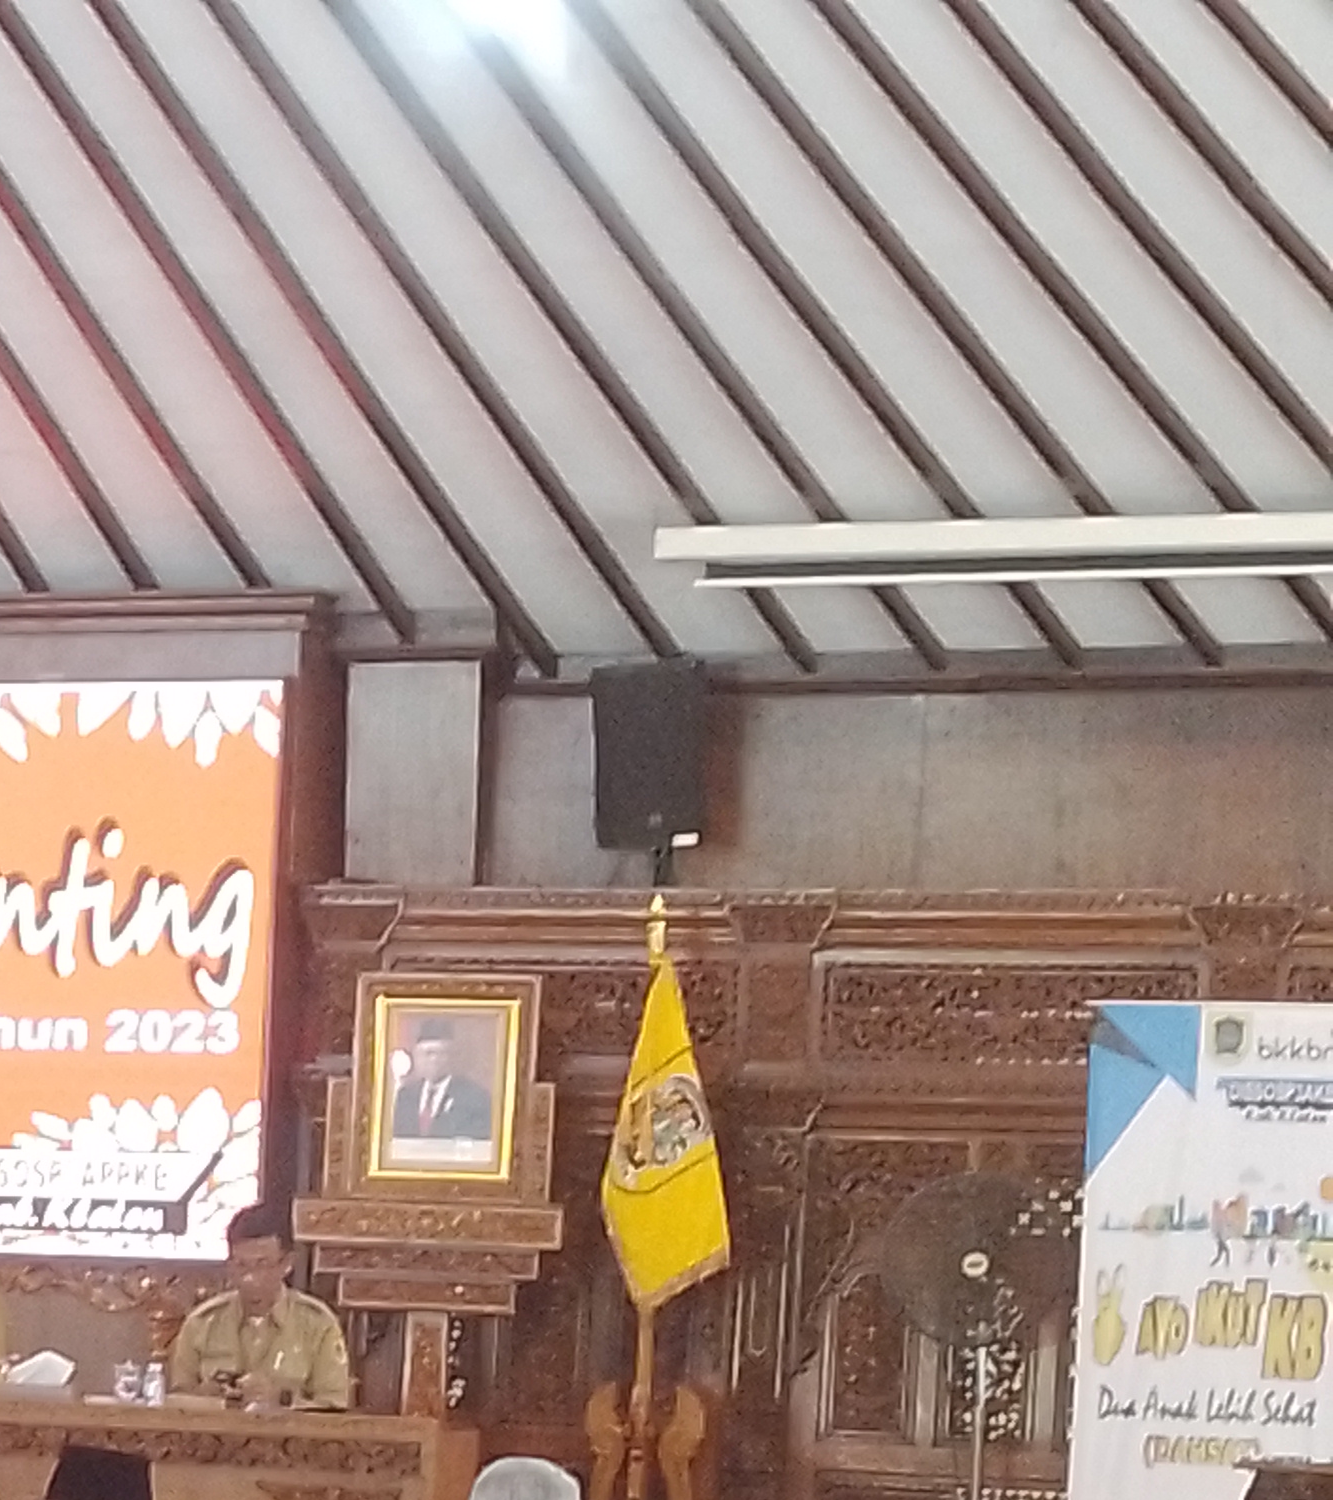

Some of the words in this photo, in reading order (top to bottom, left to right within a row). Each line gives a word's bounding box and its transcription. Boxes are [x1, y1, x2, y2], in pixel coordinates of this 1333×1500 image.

[103, 1008, 241, 1055] 2023
[1259, 1292, 1328, 1381] KB
[1141, 1386, 1197, 1421] Anak
[1260, 1390, 1318, 1426] Sehat
